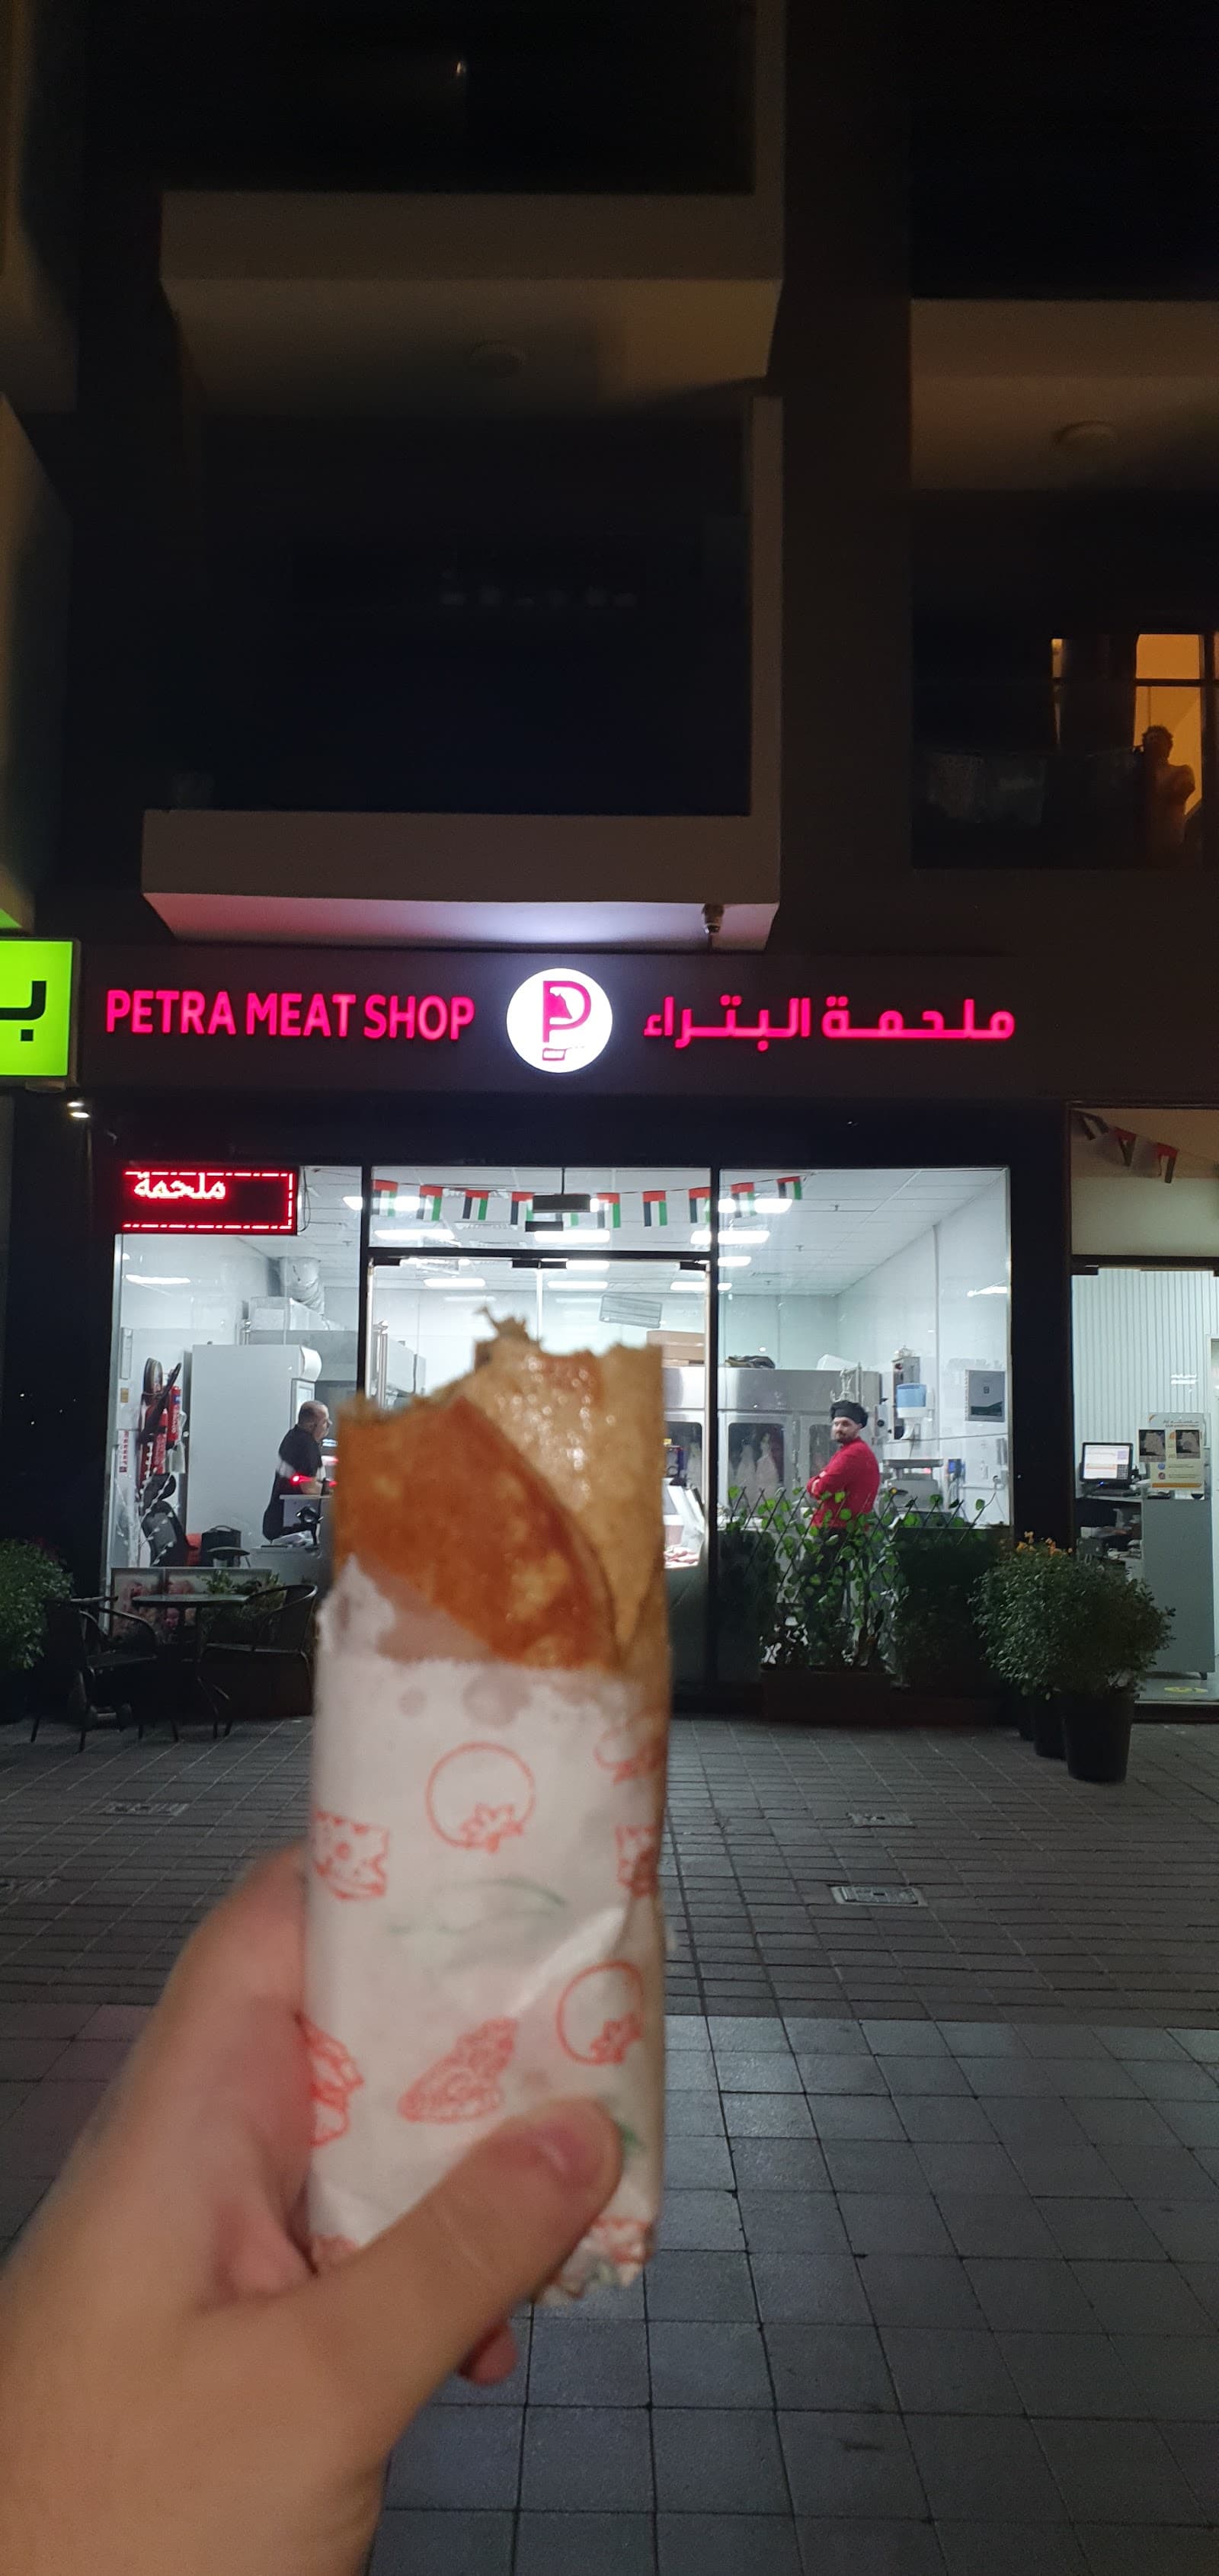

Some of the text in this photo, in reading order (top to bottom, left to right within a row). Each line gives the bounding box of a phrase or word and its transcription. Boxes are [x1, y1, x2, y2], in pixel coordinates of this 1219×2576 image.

[105, 988, 475, 1041] PETRA MEAT SHOP
[642, 994, 1016, 1052] ملحمة البتراء
[133, 1171, 226, 1200] ملحمة
